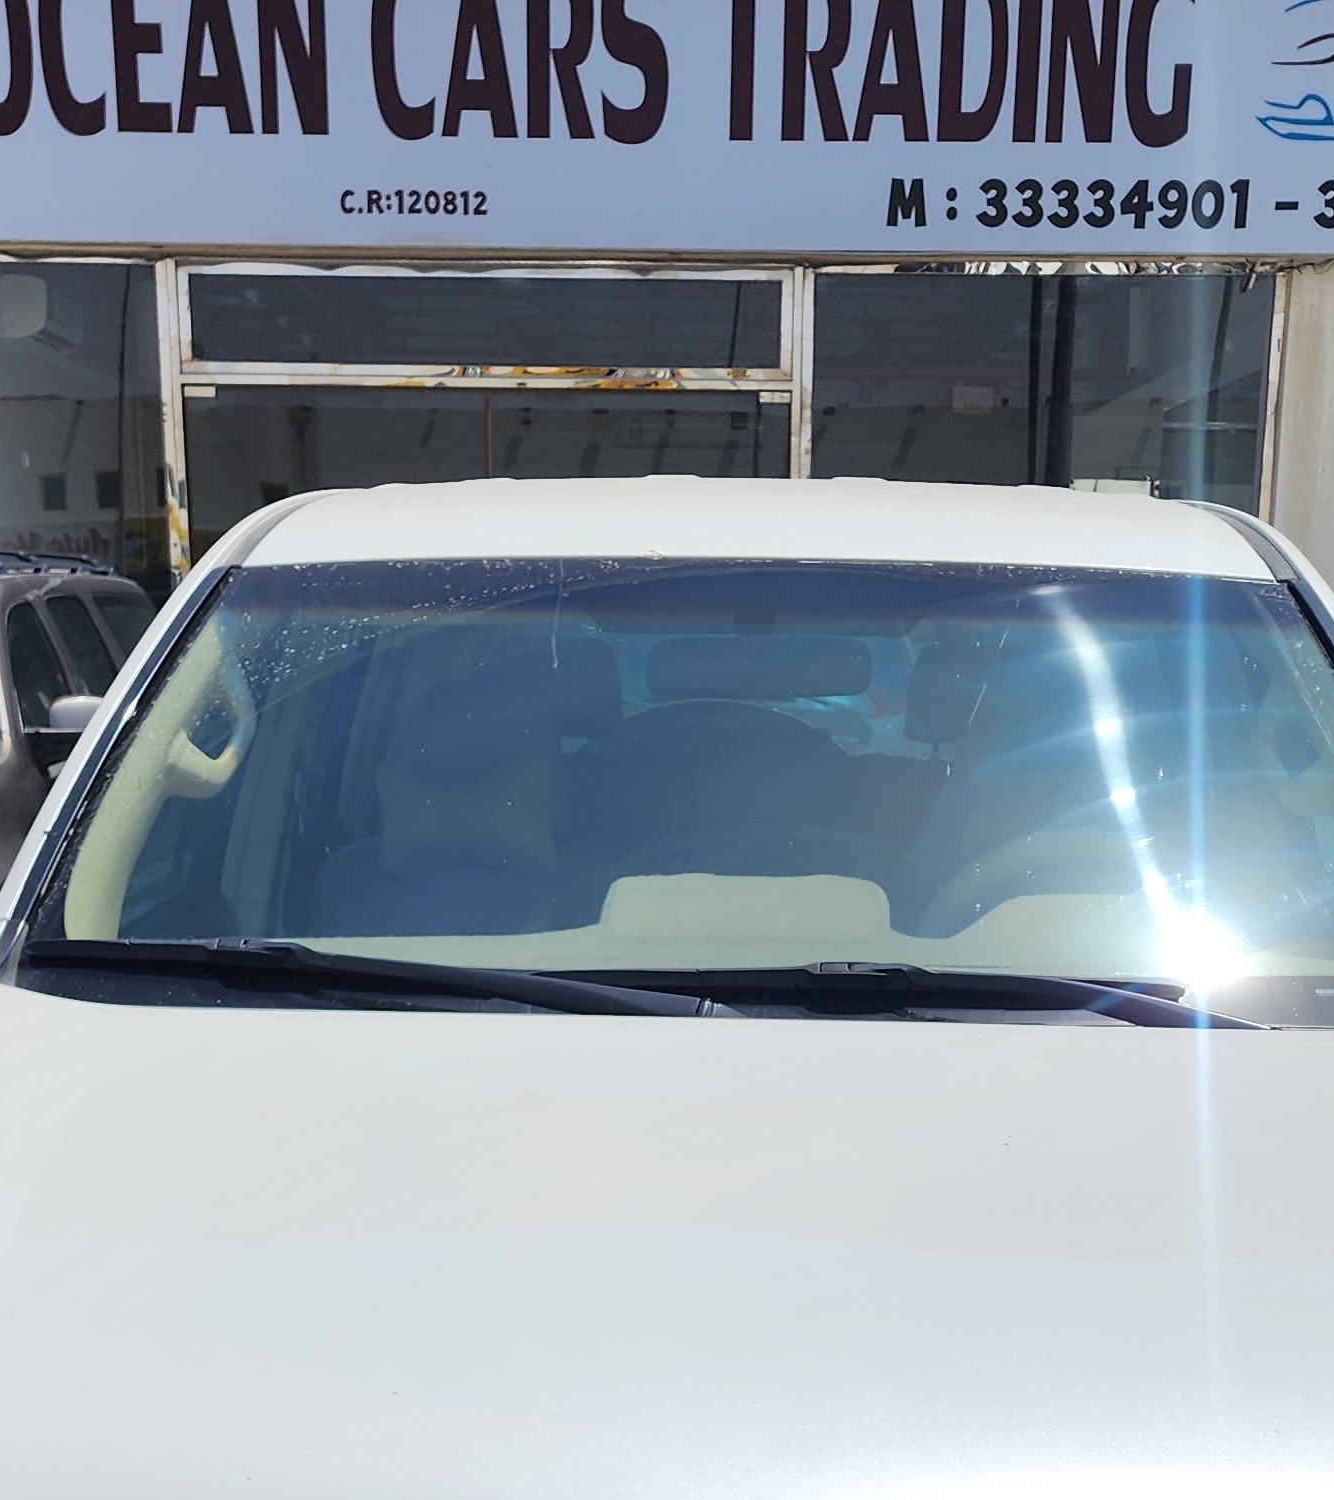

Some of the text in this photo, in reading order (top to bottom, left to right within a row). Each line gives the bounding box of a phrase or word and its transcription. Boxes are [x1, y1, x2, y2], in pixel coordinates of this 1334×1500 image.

[370, 0, 670, 146] CARS
[727, 0, 1196, 149] TRADING
[339, 189, 489, 217] C.R:120812
[976, 178, 1249, 230] 33334901
